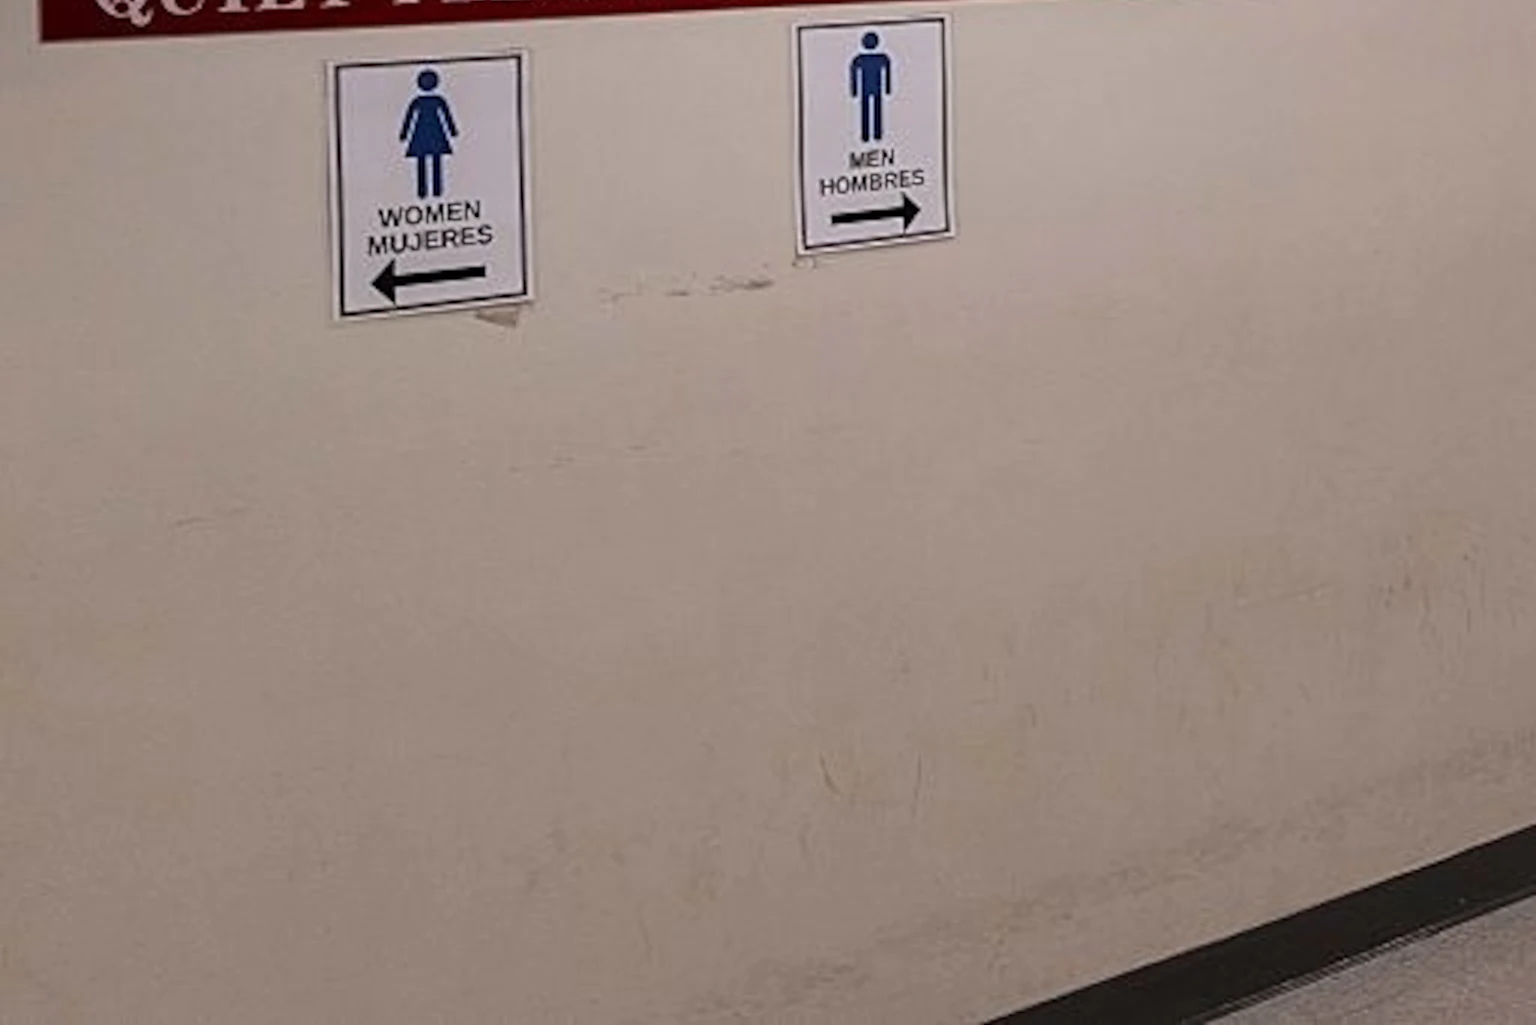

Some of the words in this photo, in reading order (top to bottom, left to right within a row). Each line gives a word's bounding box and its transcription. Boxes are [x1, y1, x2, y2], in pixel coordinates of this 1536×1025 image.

[850, 149, 894, 167] MEN
[819, 169, 925, 199] HOMBRES
[378, 200, 480, 227] WOMEN
[368, 224, 493, 255] MUJERES
